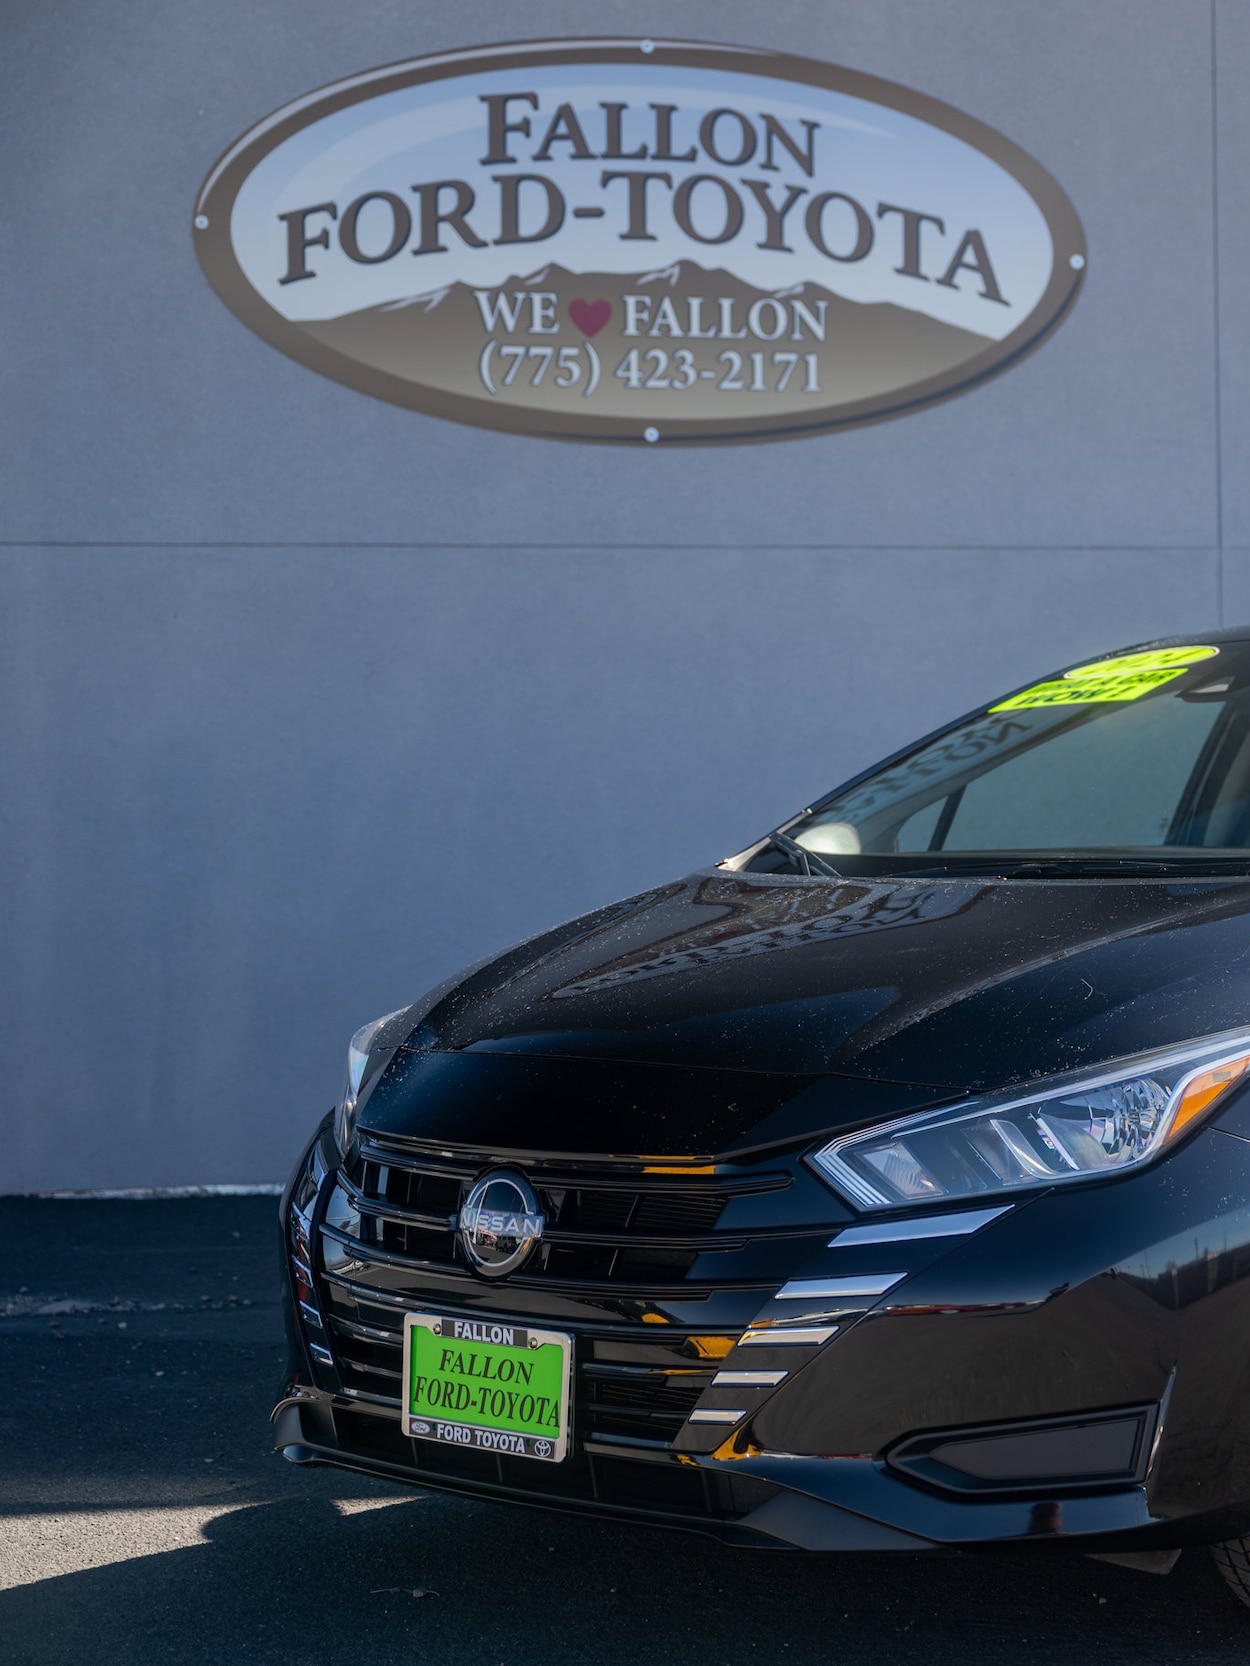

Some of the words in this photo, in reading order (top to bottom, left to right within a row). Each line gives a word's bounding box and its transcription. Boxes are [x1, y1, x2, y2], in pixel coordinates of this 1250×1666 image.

[478, 91, 821, 177] FALLON
[277, 171, 1011, 307] FORD-TOYOTA
[473, 290, 560, 335] WE
[622, 294, 828, 343] FALLON
[478, 341, 602, 397] (775)
[615, 348, 823, 392] 423-2171
[460, 1212, 541, 1235] NISSAN
[454, 1321, 514, 1345] FALLON
[438, 1348, 535, 1386] FALLON
[413, 1375, 561, 1428] FORD-TOYOTA
[436, 1423, 471, 1444] FORD
[474, 1430, 526, 1454] TOYOTA
